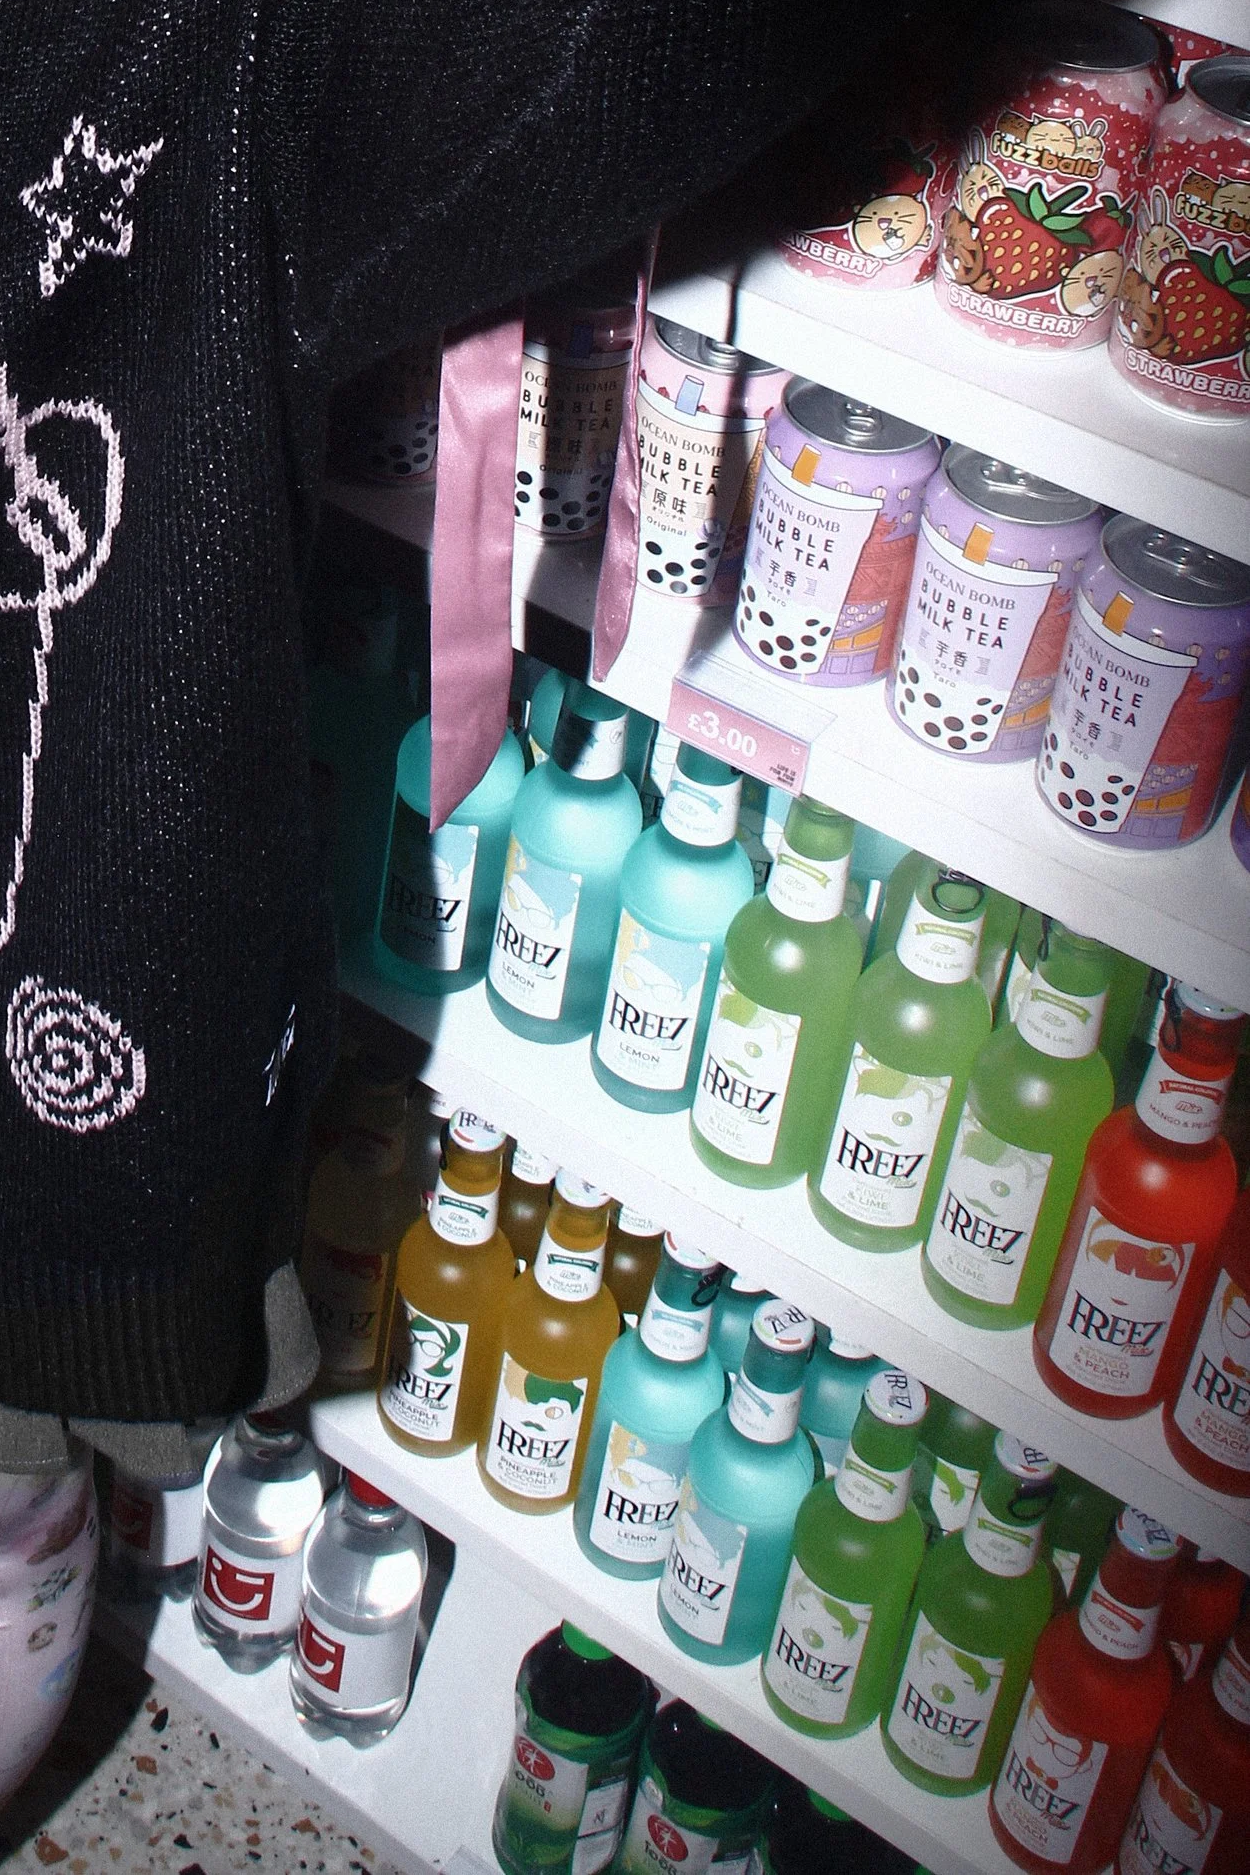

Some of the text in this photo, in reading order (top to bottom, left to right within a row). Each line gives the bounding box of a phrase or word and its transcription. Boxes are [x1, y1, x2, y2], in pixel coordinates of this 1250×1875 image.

[992, 133, 1101, 178] fuzzballs
[784, 235, 880, 275] AWBERRY
[949, 287, 1085, 336] STRAWBERRY
[1126, 350, 1250, 400] STRAWBERR
[639, 434, 722, 479] BUBBLE
[641, 415, 726, 458] OCEAN BOMB
[652, 487, 688, 516] 原味
[681, 478, 718, 498] TEA
[762, 481, 841, 534] OCEAN BOMB
[646, 515, 687, 537] Original
[755, 515, 830, 572] MILK TEA
[758, 498, 835, 554] BUBBLE
[767, 589, 787, 607] Taro
[920, 578, 1009, 631] BUBBLE
[926, 560, 1016, 611] OCEAN BOMB
[917, 596, 1004, 650] MILK TEA
[933, 671, 956, 689] Taro
[1068, 643, 1144, 709] BUBBLE
[1074, 625, 1151, 689] OCEAN BOMB
[1063, 661, 1137, 728] MILK TEA
[687, 710, 758, 758] £3.00
[496, 911, 567, 970] FREEZ
[502, 961, 535, 989] LEMON
[609, 989, 689, 1042] FREEZ
[619, 1041, 661, 1063] LEMON
[703, 1053, 781, 1114] FREEZ
[837, 1126, 928, 1180] FREEZ
[940, 1187, 1027, 1255] FREEZ
[1067, 1289, 1165, 1350] FREEZ
[1084, 1358, 1131, 1382] PEACH
[497, 1416, 571, 1461] FREEZ
[500, 1454, 557, 1481] PINEAPPLE
[505, 1466, 558, 1486] COCONUT
[603, 1487, 679, 1527] FREEZ
[617, 1529, 658, 1543] LEMON
[667, 1537, 728, 1602] FREEZ
[776, 1624, 854, 1684] FREEZ
[901, 1680, 985, 1740] FREEZ
[1005, 1749, 1081, 1818] FREEZ
